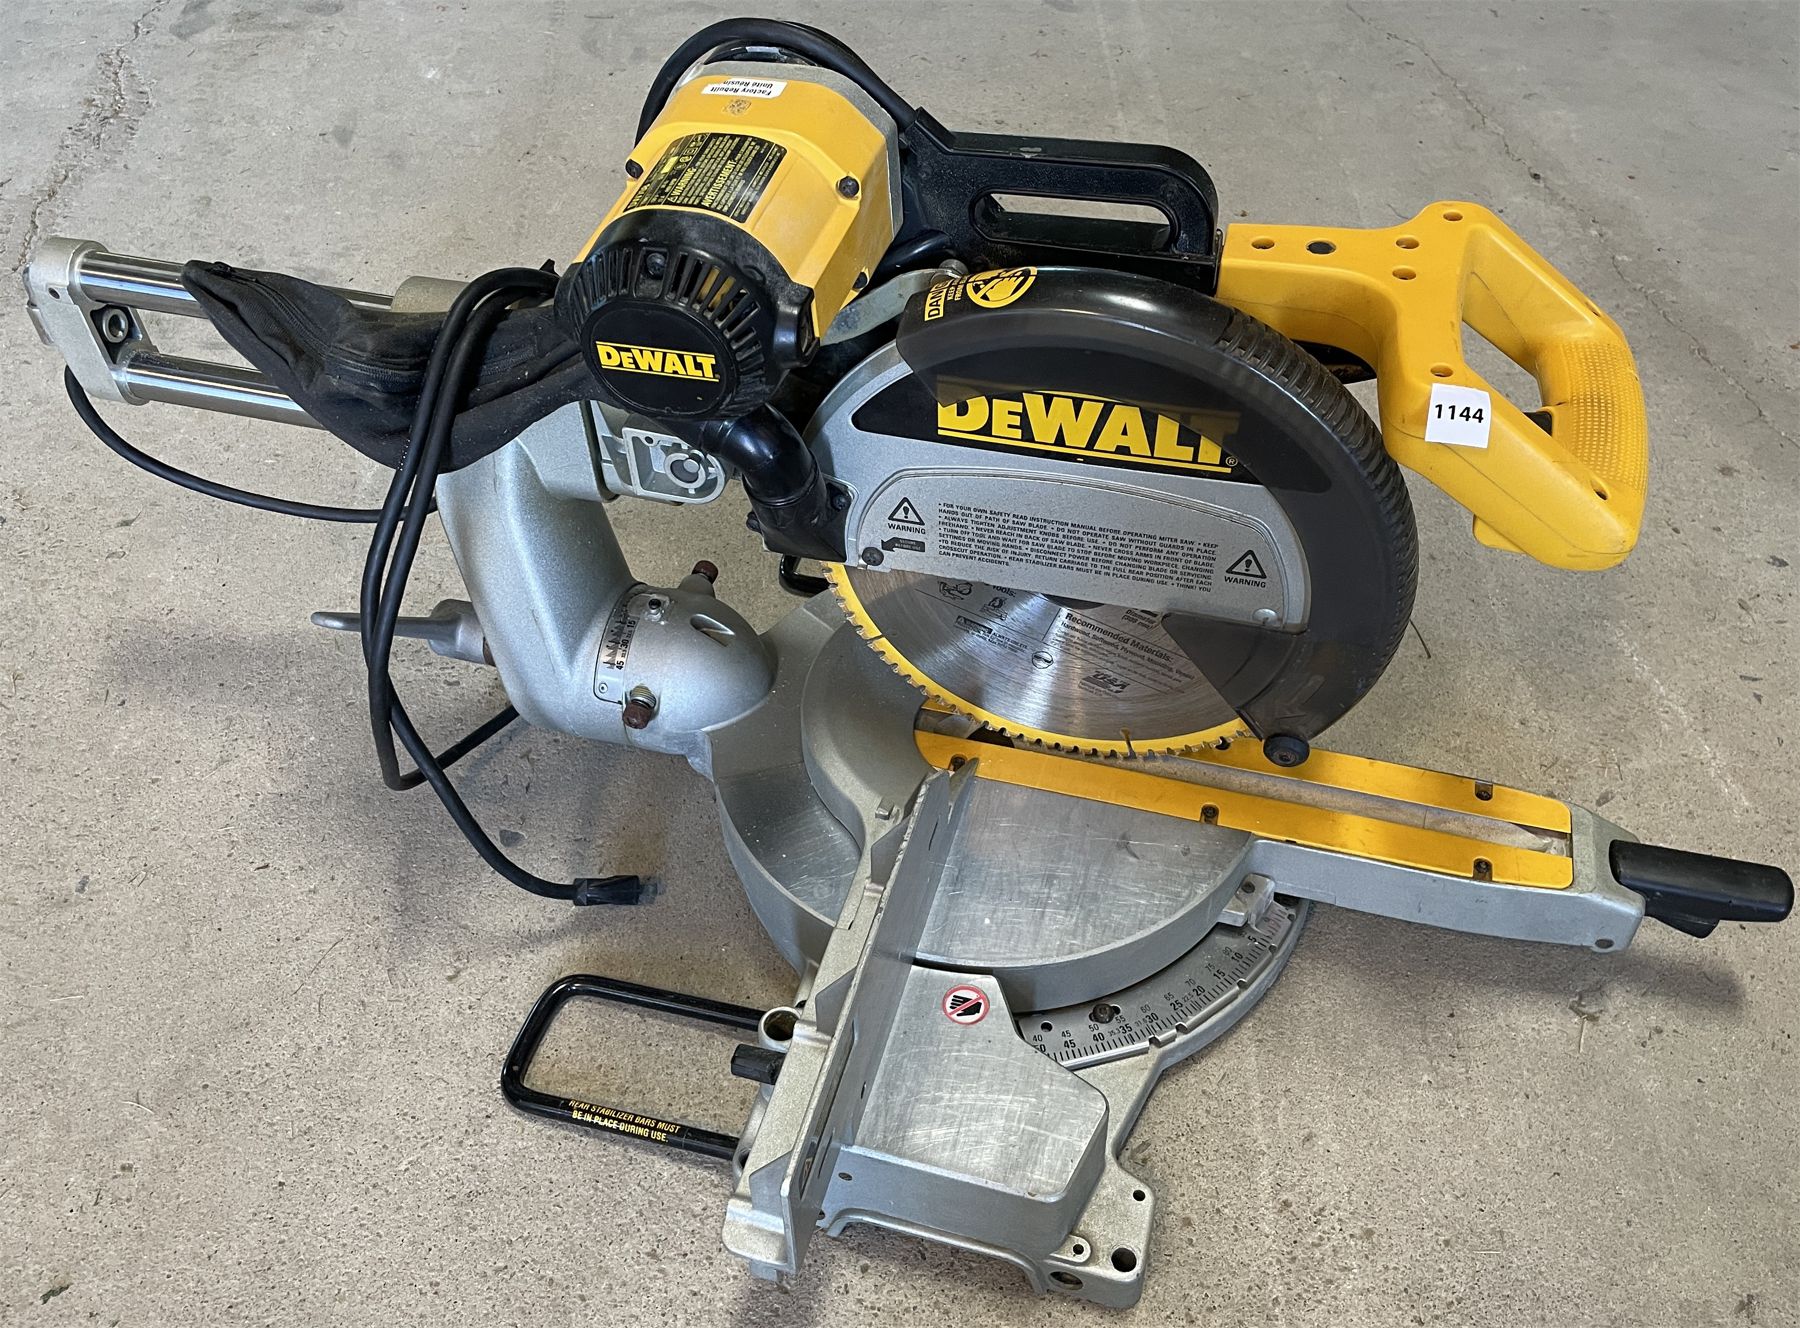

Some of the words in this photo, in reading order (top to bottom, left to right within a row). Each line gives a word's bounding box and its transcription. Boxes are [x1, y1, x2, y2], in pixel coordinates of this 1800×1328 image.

[741, 87, 771, 95] Factory
[1435, 404, 1484, 423] 1144
[887, 522, 925, 534] WARNING
[939, 508, 958, 516] HANDS
[1082, 531, 1108, 539] OPERATE
[1128, 538, 1156, 546] WITHOUT
[1159, 542, 1183, 550] GUARDS
[997, 524, 1036, 534] ADJUSTMENT
[1134, 545, 1163, 553] PERFORM
[1181, 552, 1215, 561] OPERATION
[1029, 516, 1068, 526] INSTRUCTION
[1070, 522, 1096, 530] MANUAL
[1122, 530, 1156, 539] OPERATING
[939, 544, 967, 553] CROSSCUT
[1132, 575, 1154, 583] DURING
[950, 540, 971, 548] REDUCE
[1059, 558, 1087, 566] CARRIAGE
[1145, 571, 1173, 580] POSITION
[1030, 547, 1066, 557] DISCONNECT
[1115, 560, 1146, 569] CHANGING
[1094, 551, 1115, 559] BEFORE
[1117, 555, 1141, 563] MOVING
[1181, 564, 1213, 573] CHANGING
[1224, 576, 1267, 588] WARNING
[616, 660, 624, 670] 45
[620, 640, 629, 648] 30
[627, 620, 635, 628] 15
[1065, 612, 1129, 645] Recommended
[1130, 638, 1173, 663] Materials:
[1092, 669, 1130, 691] USA
[1062, 1030, 1071, 1038] 45
[1089, 1024, 1099, 1032] 50
[1115, 1015, 1126, 1024] 55
[1140, 1004, 1151, 1013] 60
[1164, 992, 1175, 1001] 65
[1205, 963, 1215, 972] 75
[1064, 1040, 1076, 1048] 45
[1092, 1033, 1105, 1042] 40
[1119, 1024, 1133, 1034] 35
[1145, 1012, 1159, 1023] 30
[1170, 999, 1183, 1011] 25
[1193, 985, 1206, 996] 20
[1213, 969, 1226, 980] 15
[1231, 952, 1243, 962] 10
[569, 1099, 590, 1110] REAR
[591, 1105, 634, 1122] STABILIZER
[635, 1116, 656, 1127] BARS
[657, 1121, 681, 1134] MUST
[572, 1110, 582, 1119] BE
[583, 1114, 593, 1122] IN
[594, 1116, 618, 1129] PLACE
[619, 1123, 649, 1138] DURING
[651, 1130, 669, 1143] USE.
